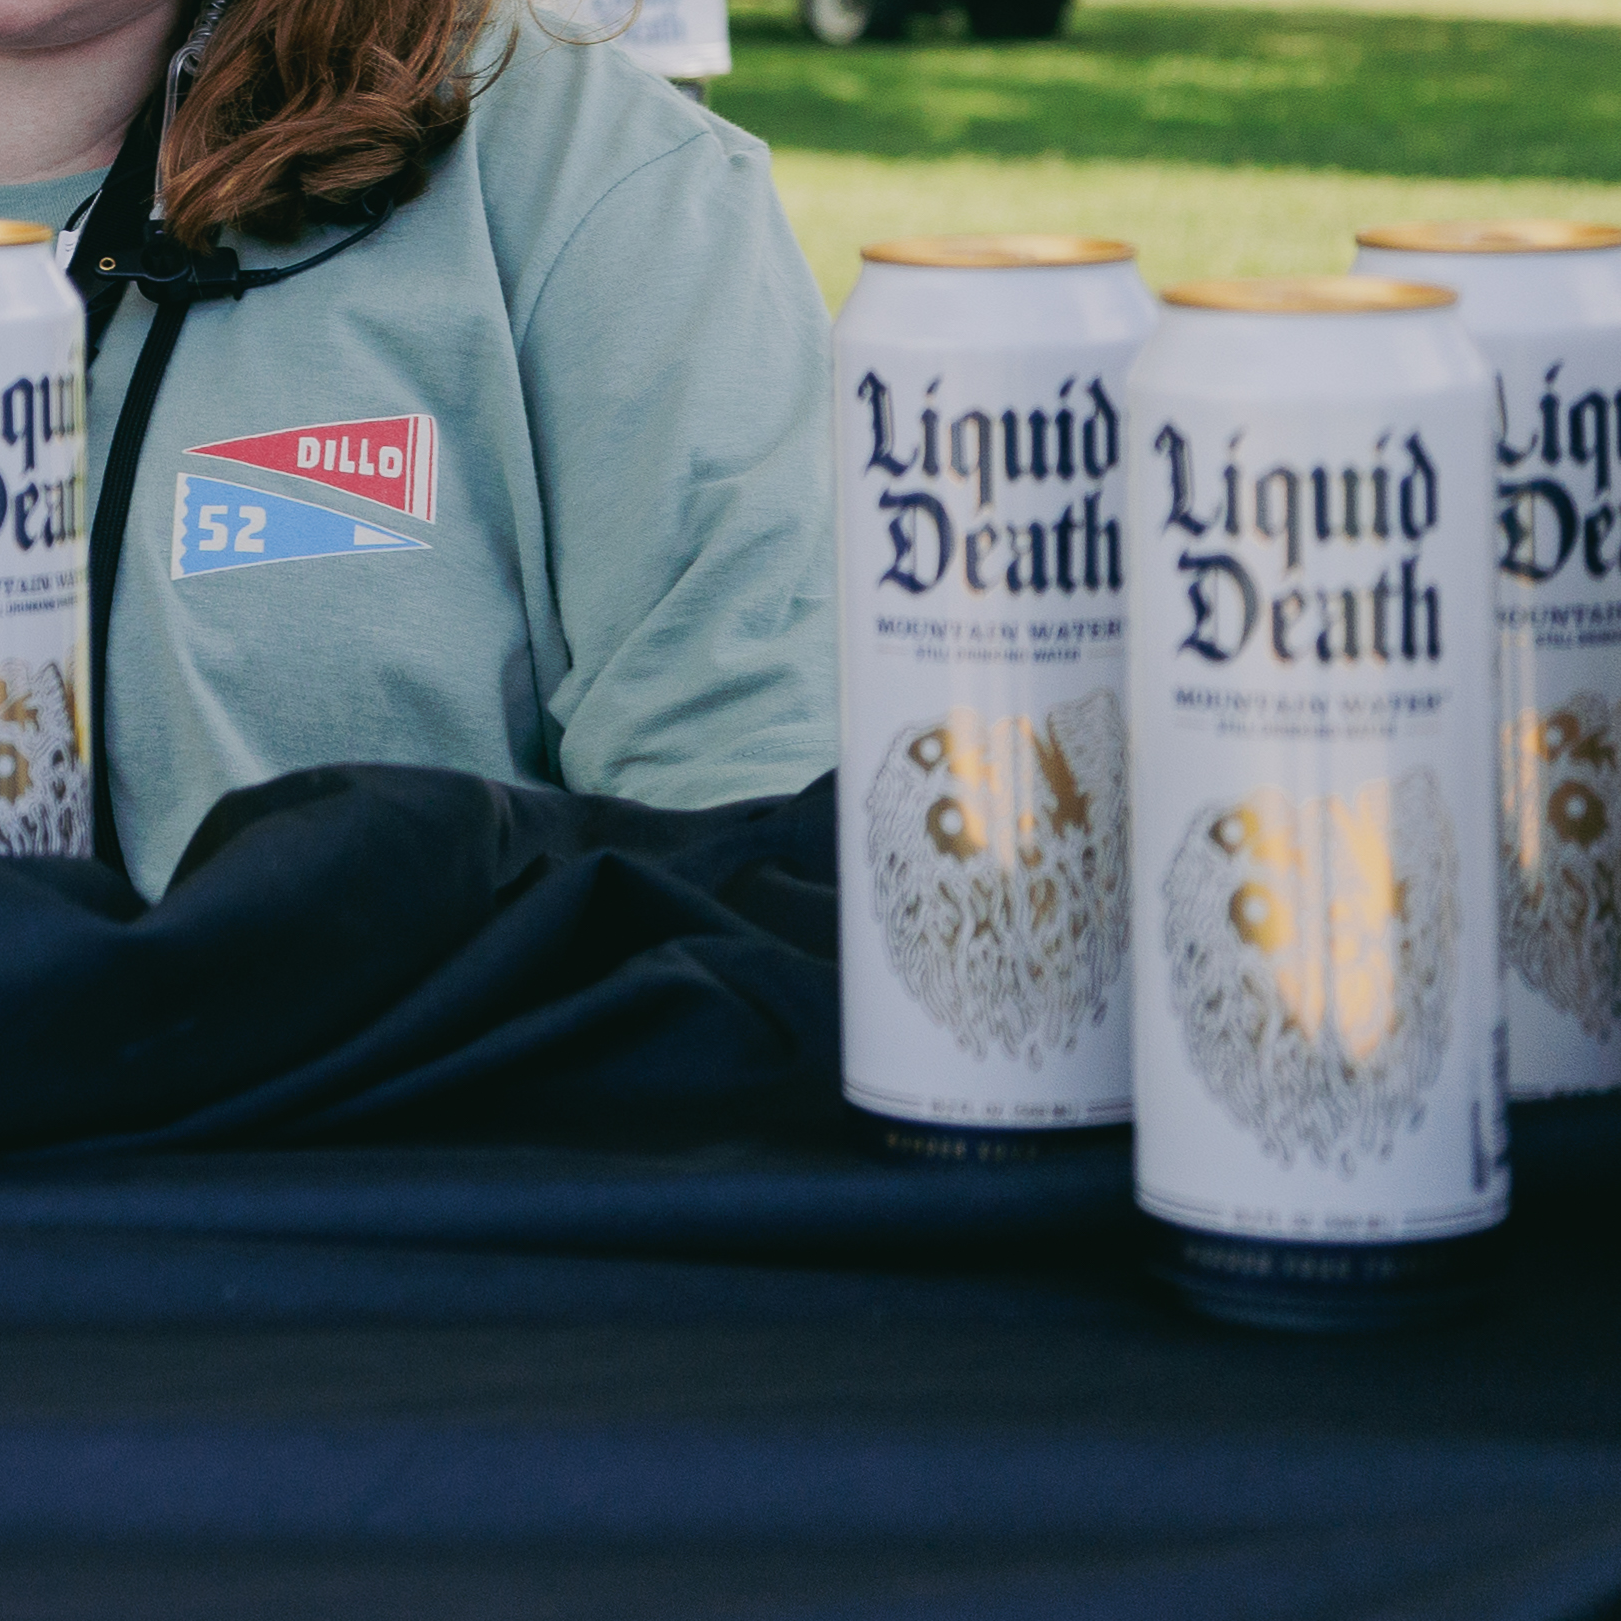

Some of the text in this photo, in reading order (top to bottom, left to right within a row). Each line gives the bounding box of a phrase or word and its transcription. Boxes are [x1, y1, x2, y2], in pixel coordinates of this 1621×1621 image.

[297, 436, 404, 479] DILLO
[857, 368, 1122, 517] Liquid
[1154, 420, 1439, 574] Liquid
[197, 504, 267, 554] 52
[877, 488, 1125, 597] Death
[1176, 548, 1443, 668] Death
